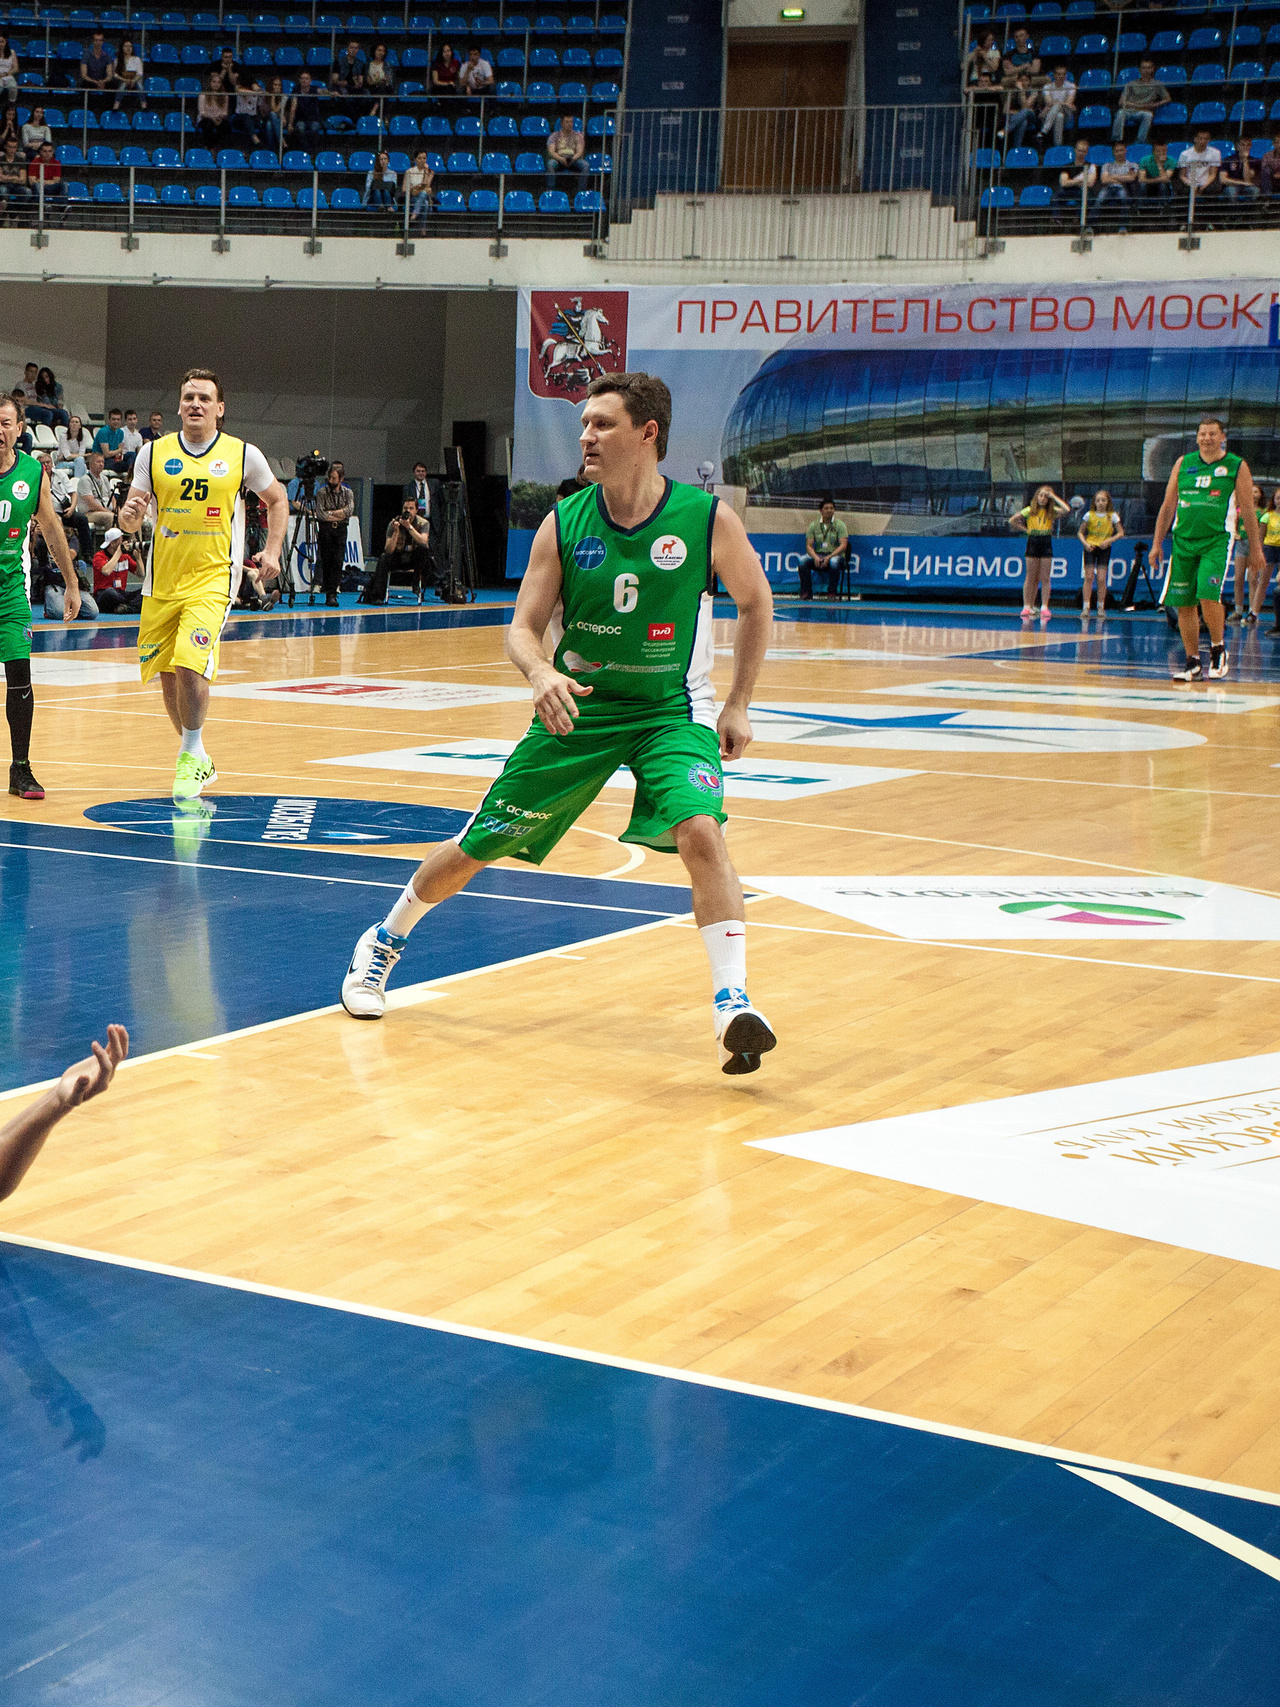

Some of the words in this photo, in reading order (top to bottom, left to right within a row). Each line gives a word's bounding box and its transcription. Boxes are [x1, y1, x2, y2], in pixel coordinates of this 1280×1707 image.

[675, 295, 1096, 334] ПРАВИТЕЛЬСТВО
[1111, 292, 1280, 332] МОСК
[180, 478, 209, 501] 25
[1195, 476, 1212, 488] 19
[1050, 557, 1068, 578] в
[613, 573, 640, 613] 6
[576, 621, 622, 635] астерос
[261, 799, 318, 841] МОСОБЛГАЗ
[506, 804, 552, 820] астерос
[1054, 1127, 1163, 1150] КЛУБ
[1109, 1121, 1280, 1167] ВСКИЙ
